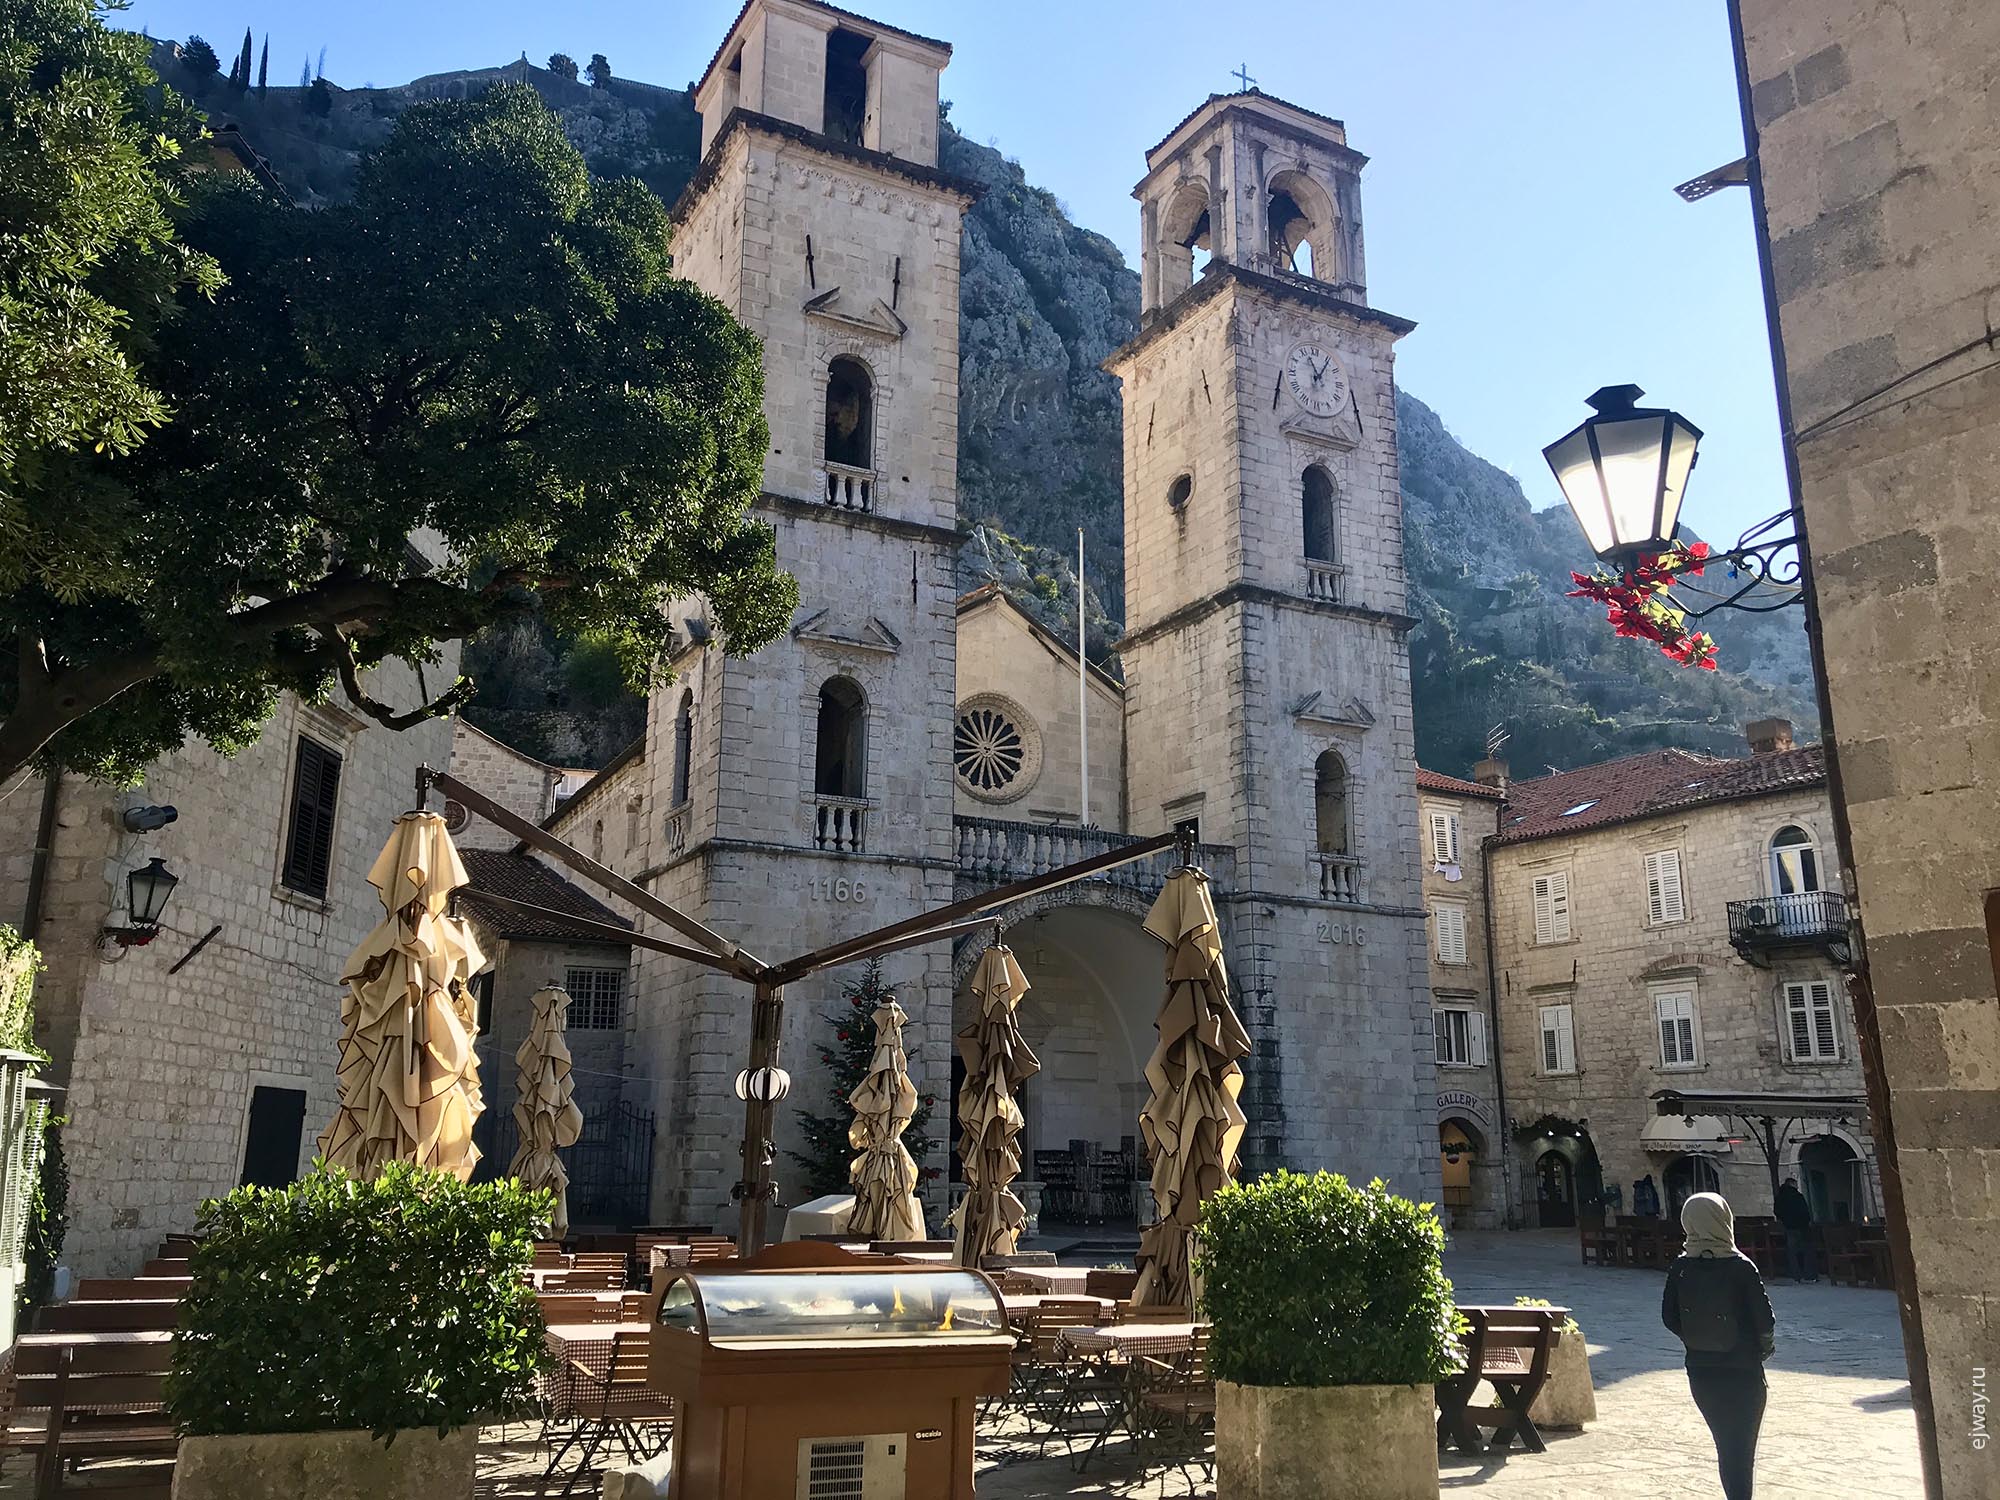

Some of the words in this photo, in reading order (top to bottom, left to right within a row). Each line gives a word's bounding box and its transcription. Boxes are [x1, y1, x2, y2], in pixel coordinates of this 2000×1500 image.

[808, 876, 867, 903] 1166
[1317, 922, 1367, 946] 2016
[1437, 1094, 1477, 1108] GALLERY
